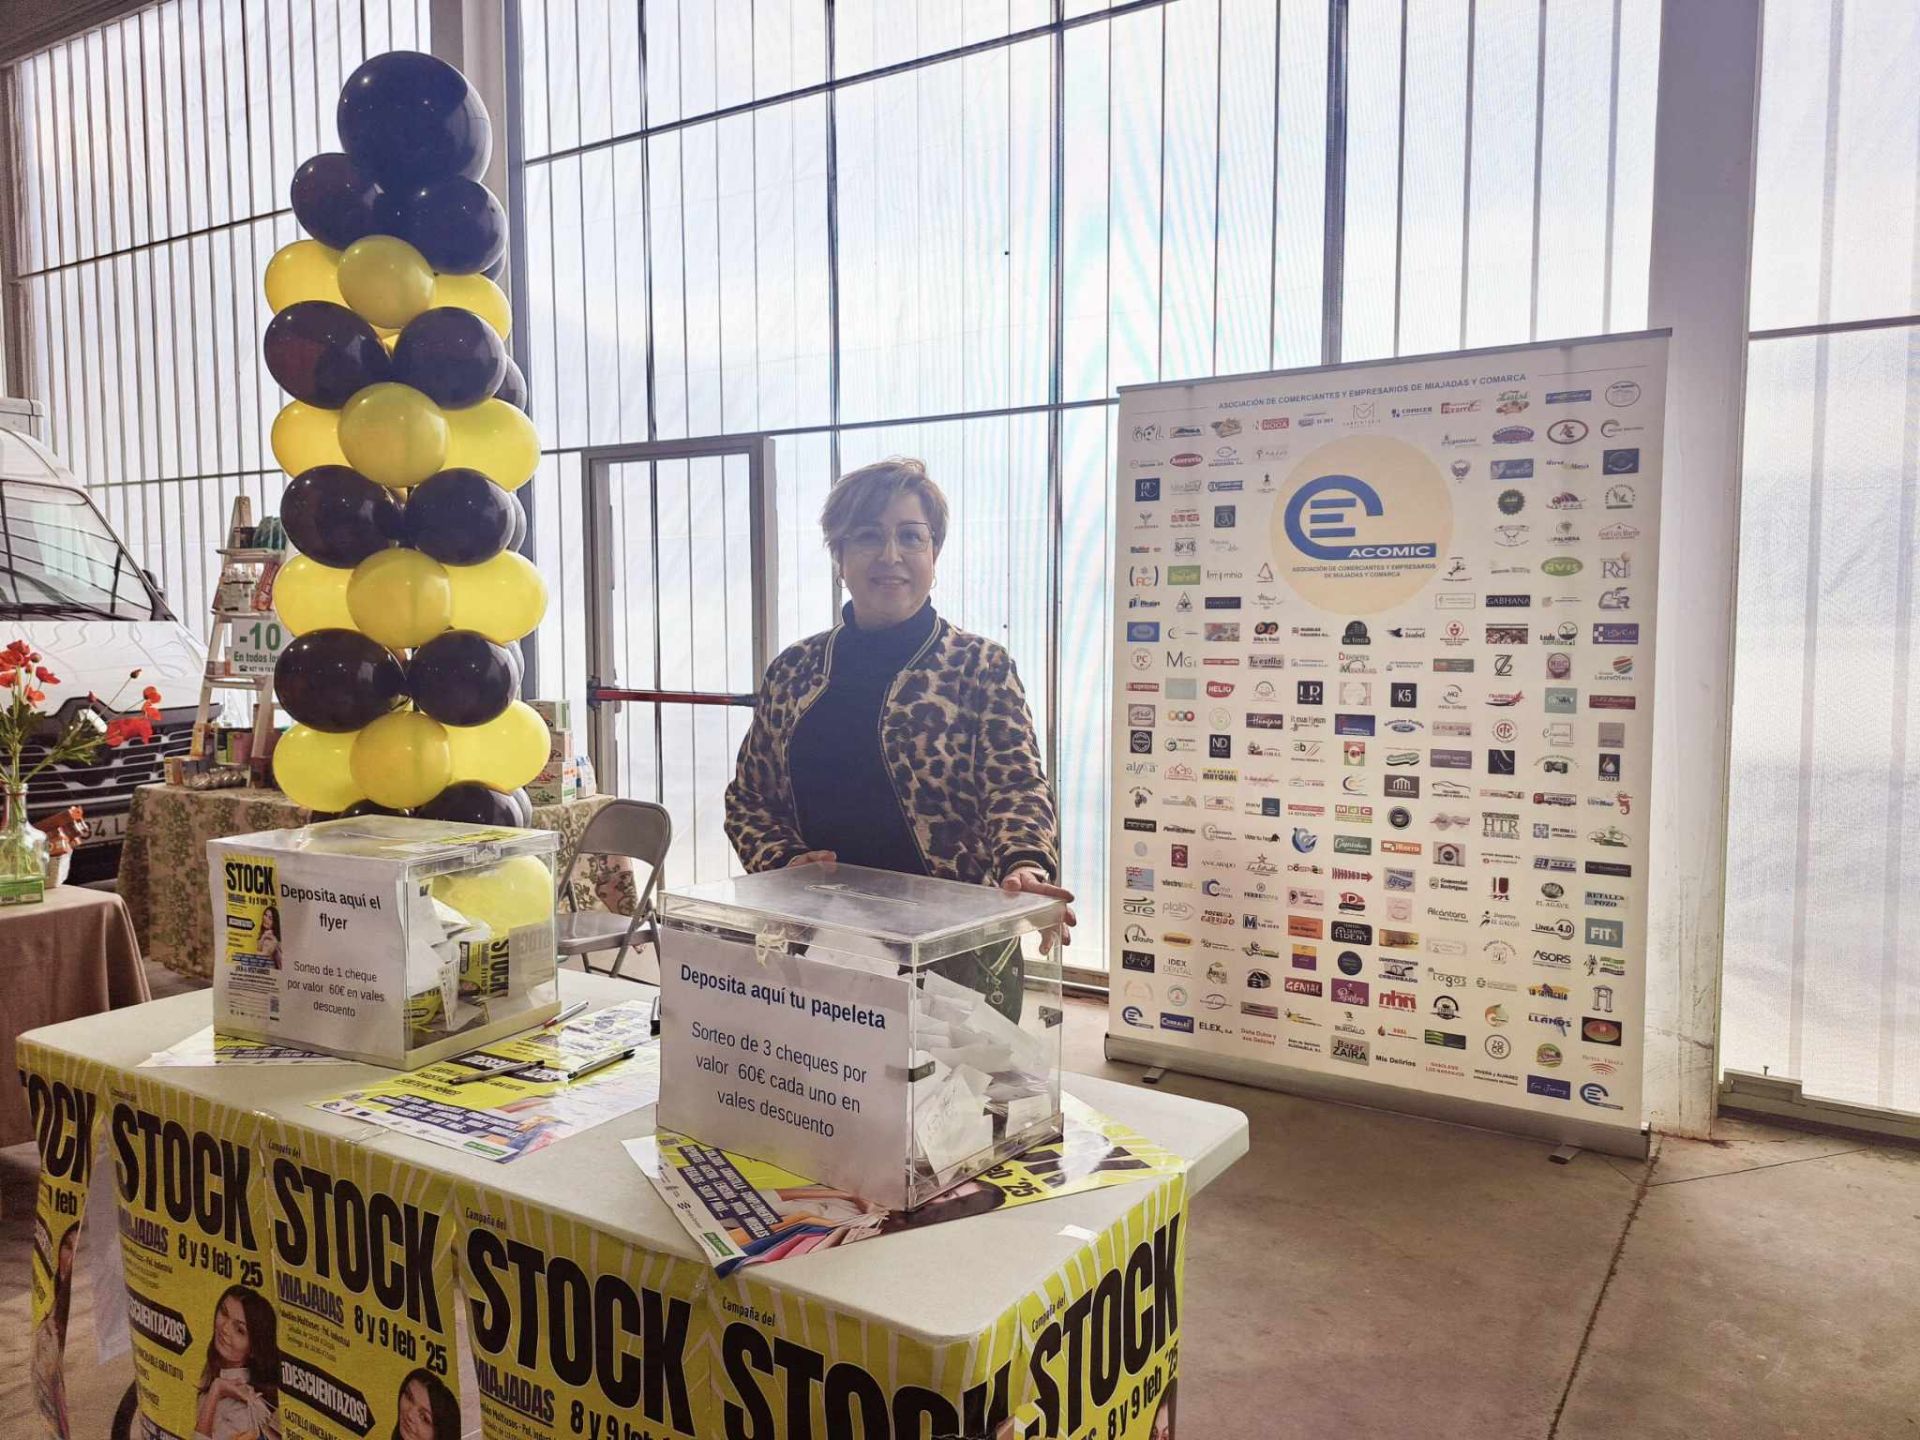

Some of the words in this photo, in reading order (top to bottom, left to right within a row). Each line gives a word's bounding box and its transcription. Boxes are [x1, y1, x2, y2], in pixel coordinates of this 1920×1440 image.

[1266, 397, 1277, 405] DE
[1278, 390, 1340, 403] COMERCIANTES
[1349, 384, 1409, 397] EMPRESARIOS
[1411, 383, 1423, 391] DE
[1425, 378, 1473, 391] MIAJADAS
[1480, 374, 1526, 385] COMARCA
[1348, 545, 1431, 559] ACOMIC
[234, 651, 244, 662] En
[246, 652, 268, 663] todos
[1397, 689, 1412, 703] K5
[1484, 817, 1519, 833] HTR
[224, 861, 275, 896] STOCK
[280, 883, 338, 905] Deposita
[339, 893, 367, 911] aquí
[369, 895, 381, 911] el
[319, 913, 347, 931] flyer
[1557, 922, 1572, 933] 4.0
[293, 960, 321, 976] Sorteo
[322, 965, 334, 977] de
[336, 966, 343, 977] 1
[344, 967, 378, 984] cheque
[287, 979, 300, 991] por
[301, 980, 323, 992] valor
[328, 983, 345, 997] 60€
[346, 987, 358, 998] en
[359, 987, 385, 1002] vales
[680, 963, 747, 997] Deposita
[750, 983, 786, 1006] aquí
[790, 991, 805, 1011] tu
[811, 998, 887, 1030] papeleta
[1286, 982, 1321, 995] GENIAL
[313, 1000, 356, 1017] descuento
[691, 1020, 736, 1047] Sorteo
[740, 1034, 759, 1052] de
[763, 1039, 772, 1057] 3
[776, 1044, 839, 1075] cheques
[843, 1062, 868, 1084] por
[1332, 1046, 1367, 1061] ZAIRA
[1337, 1039, 1364, 1051] Bazar
[1375, 1055, 1388, 1063] Mis
[1389, 1057, 1416, 1067] Delirios
[695, 1054, 730, 1075] valor
[738, 1063, 766, 1085] 60€
[770, 1071, 805, 1097] cada
[809, 1085, 837, 1107] uno
[842, 1096, 861, 1114] en
[717, 1090, 756, 1113] vales
[760, 1100, 835, 1138] descuento
[112, 1102, 259, 1252] STOCK
[465, 1206, 497, 1228] Campaña
[496, 1219, 508, 1231] del
[178, 1232, 188, 1260] 8
[189, 1240, 198, 1268] y
[200, 1242, 210, 1270] 9
[212, 1246, 233, 1280] feb
[273, 1157, 444, 1335] STOCK
[276, 1269, 345, 1324] MIAJADAS
[354, 1304, 364, 1335] 8
[366, 1314, 377, 1344] y
[379, 1317, 389, 1348] 9
[392, 1323, 417, 1362] feb
[722, 1296, 761, 1322] Campaña
[760, 1313, 776, 1327] del
[1024, 1211, 1181, 1440] STOCK
[1031, 1304, 1058, 1334] Campaña
[466, 1227, 697, 1438] STOCK
[281, 1360, 369, 1429] ¡DESCUENTAZOS!
[722, 1321, 1013, 1440] STOCK
[1107, 1407, 1117, 1440] 8
[1119, 1399, 1129, 1438] y
[1131, 1385, 1141, 1420] 9
[1143, 1364, 1163, 1409] feb
[571, 1399, 585, 1435] 8
[588, 1410, 603, 1440] y
[606, 1414, 620, 1440] 9
